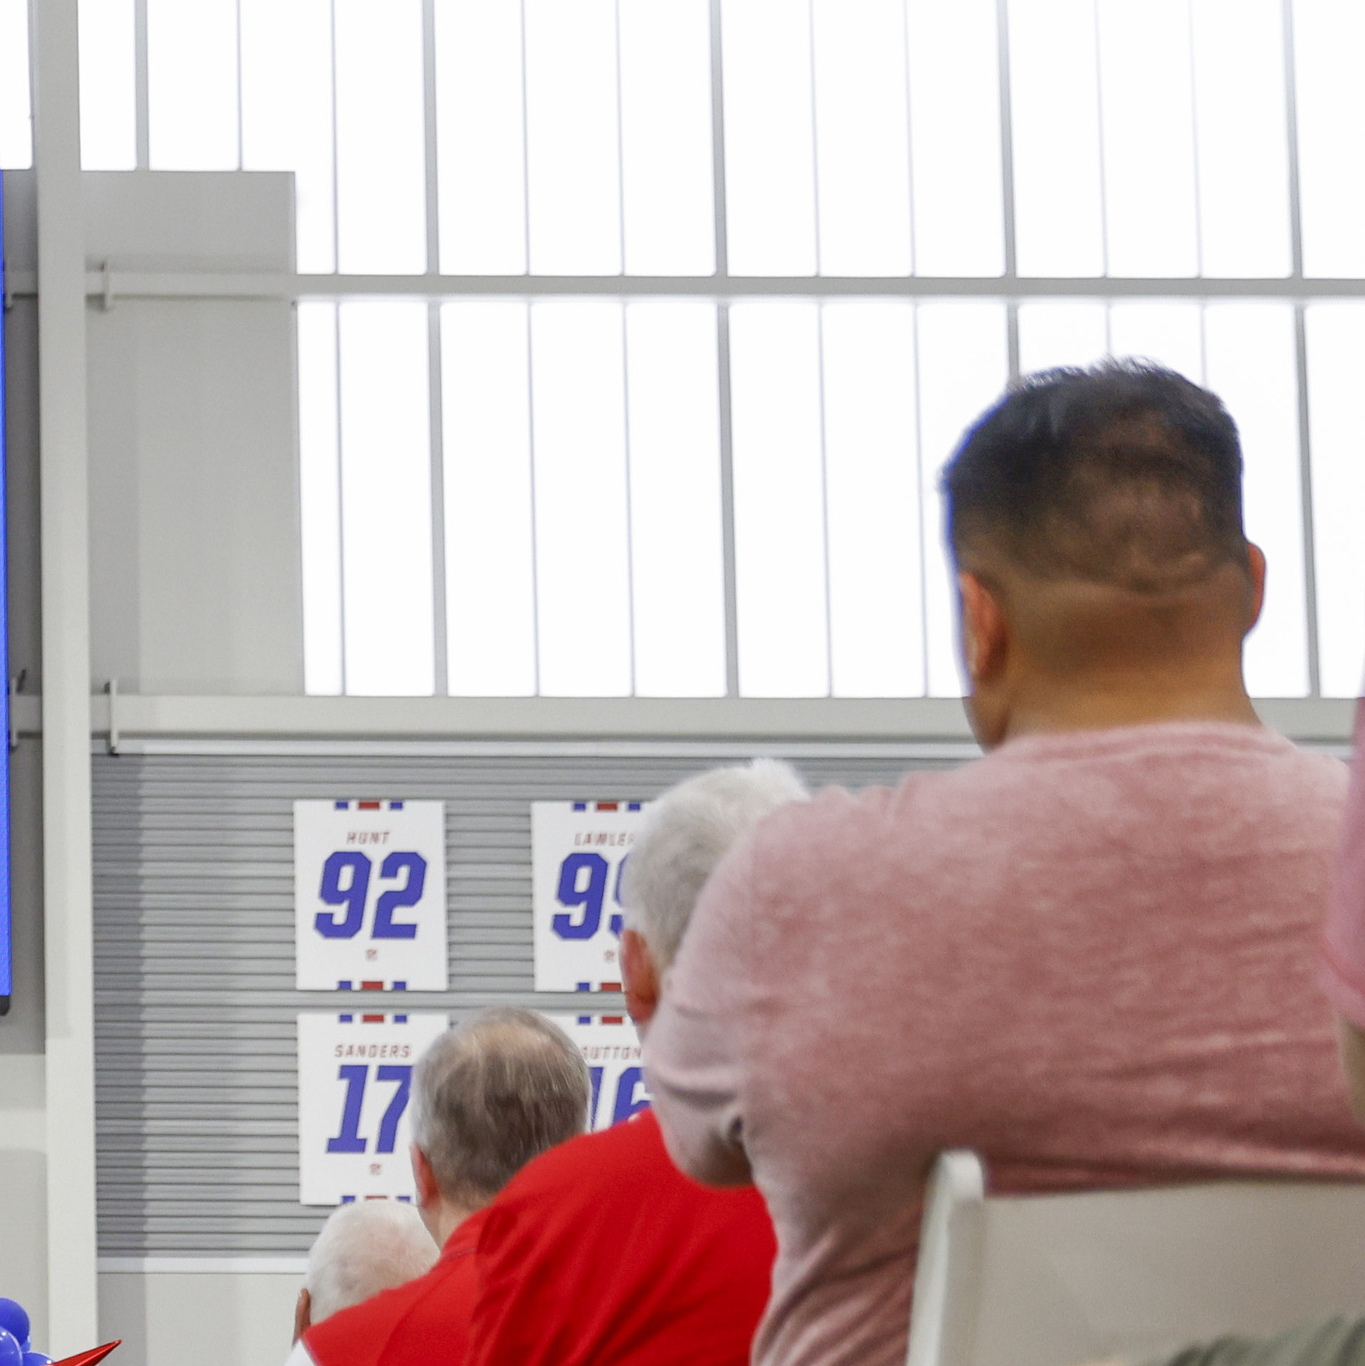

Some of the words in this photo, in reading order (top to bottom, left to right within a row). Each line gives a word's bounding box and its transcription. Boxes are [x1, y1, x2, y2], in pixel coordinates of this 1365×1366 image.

[313, 851, 428, 940] 92
[334, 1044, 412, 1059] SANDERS
[326, 1064, 414, 1154] 17
